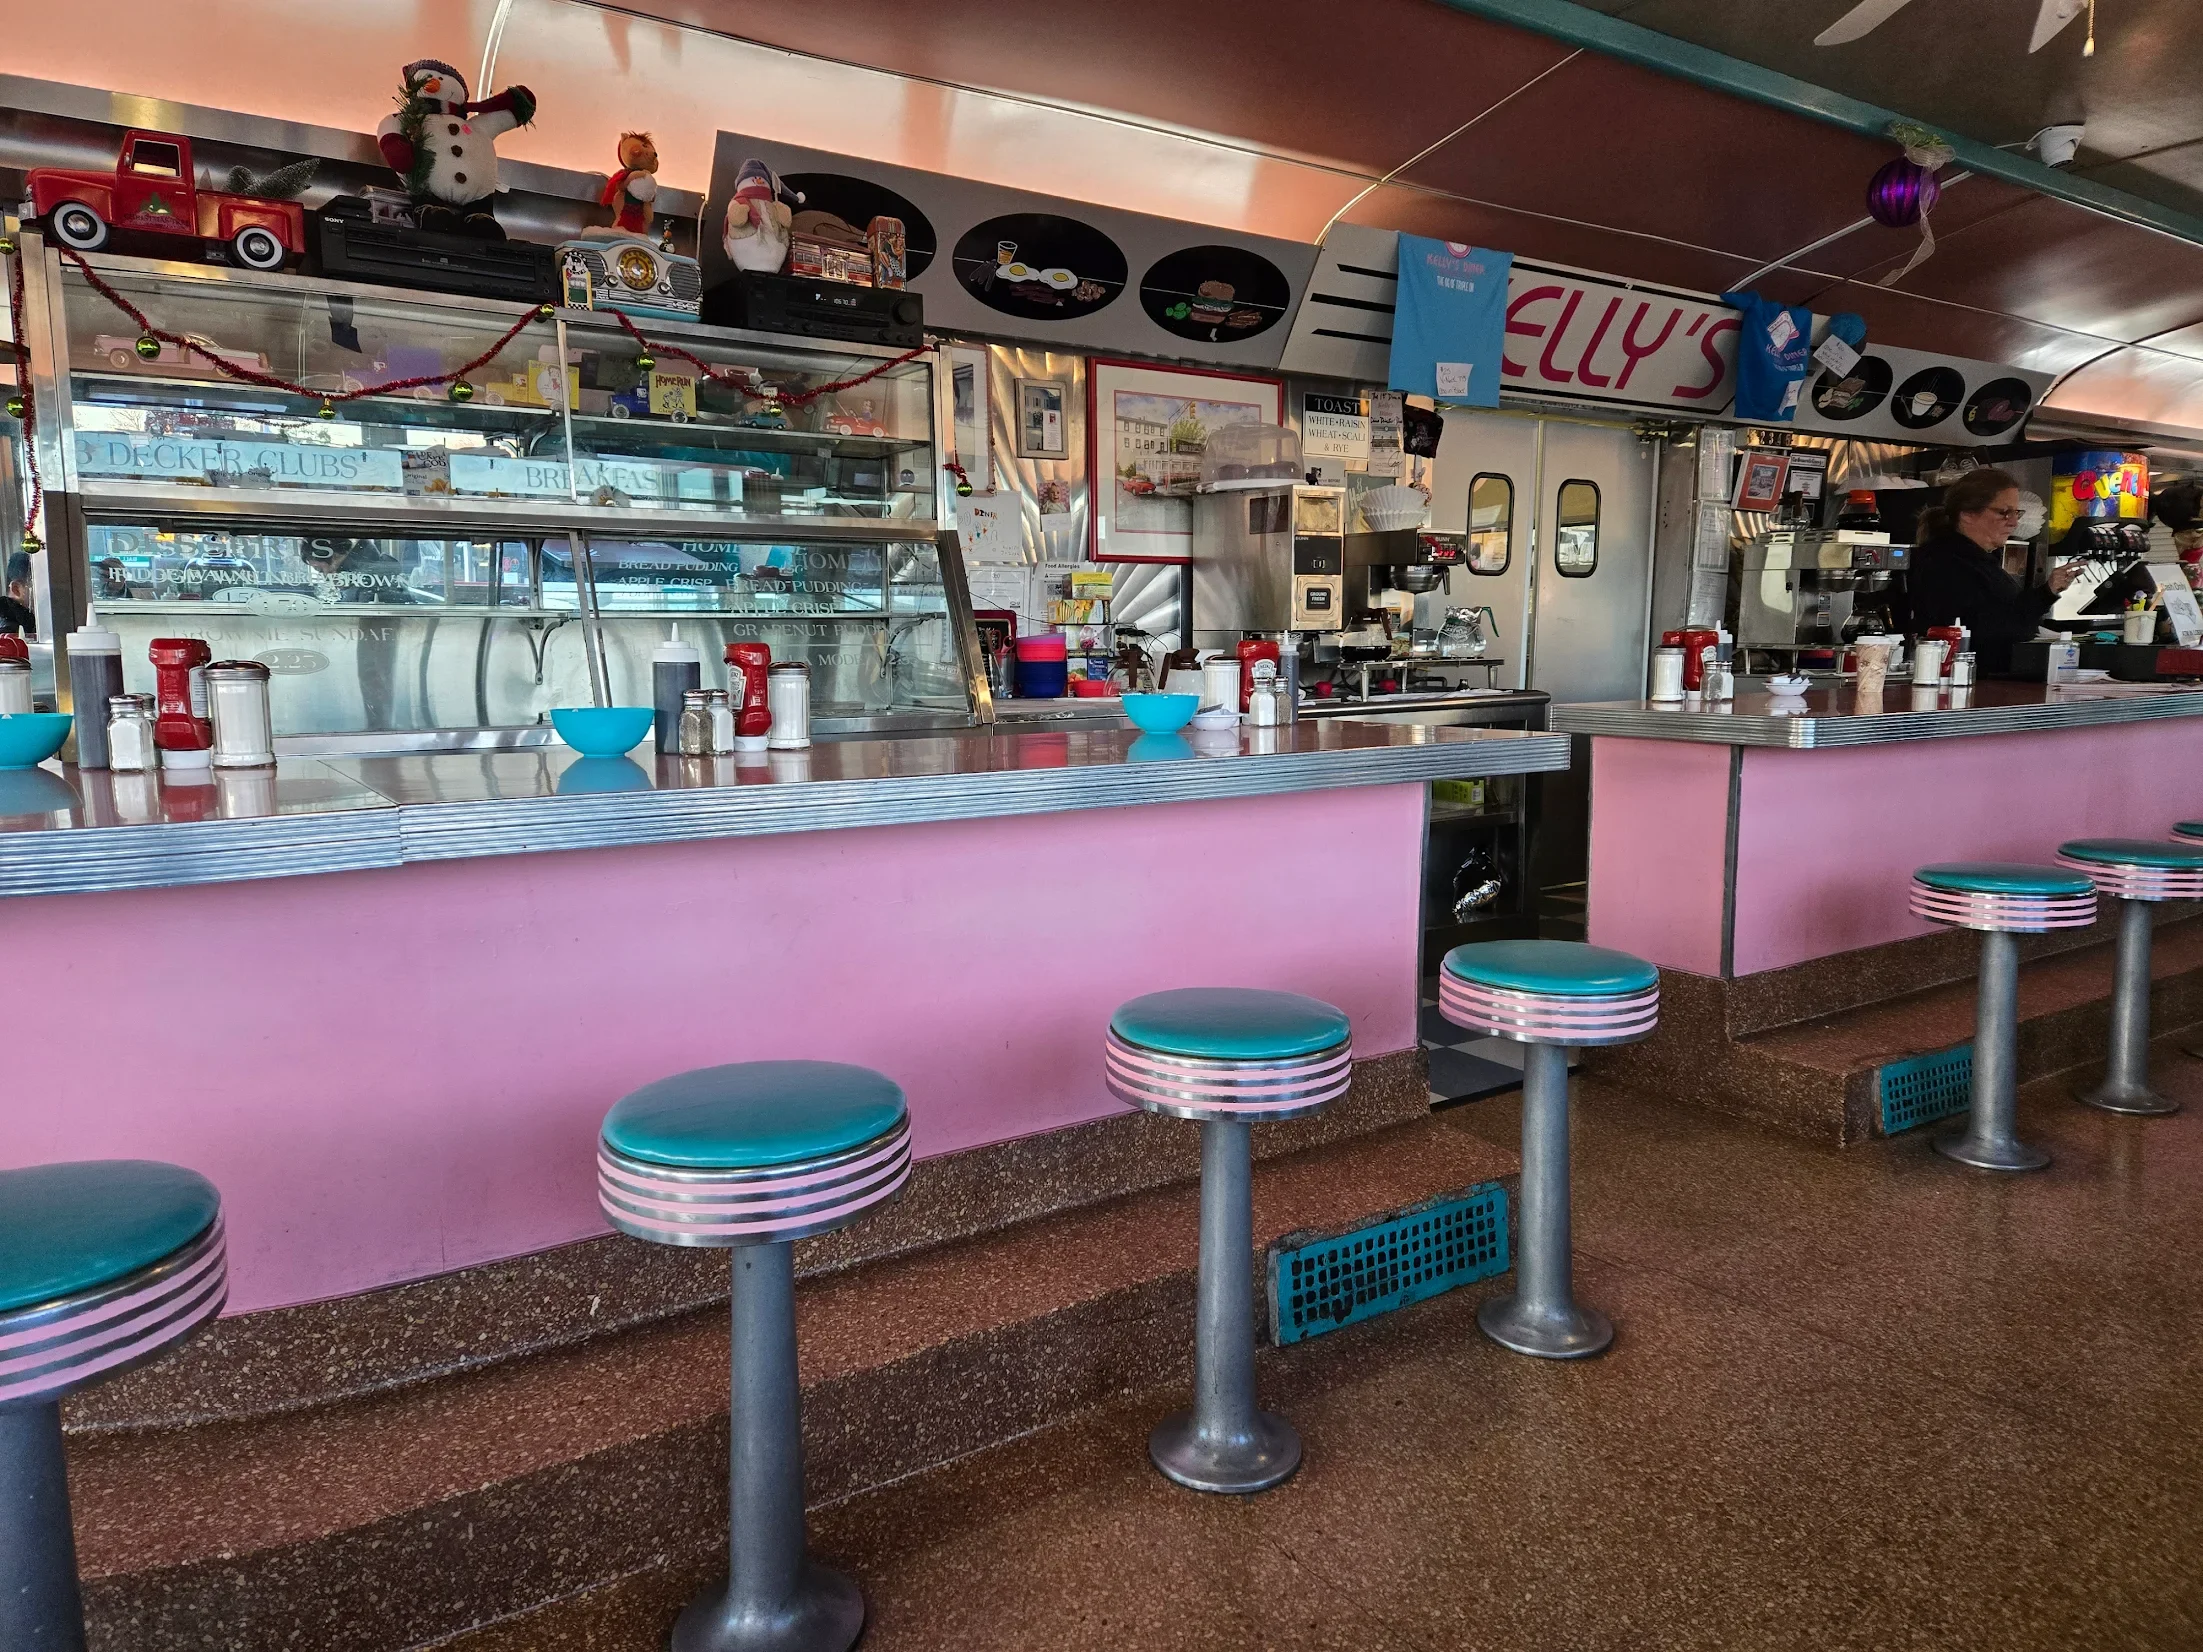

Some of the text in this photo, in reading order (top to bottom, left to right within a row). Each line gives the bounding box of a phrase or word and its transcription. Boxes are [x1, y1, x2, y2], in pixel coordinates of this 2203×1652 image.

[324, 216, 345, 224] SONY
[1426, 253, 1486, 275] KELLY'S DINER
[1502, 278, 1743, 399] ELLY'S
[1314, 397, 1361, 414] TOAST
[1308, 415, 1335, 426] WHITE
[1339, 416, 1366, 429] RAISIN
[1308, 428, 1337, 438] WHEAT
[1760, 430, 1766, 445] 2
[1768, 431, 1774, 446] 3
[1324, 443, 1349, 453] & RYE
[108, 441, 243, 473] DECKER
[255, 449, 358, 479] CLUBS
[526, 465, 664, 491] BREAKFAS
[618, 560, 739, 572] BREAD PUDDING
[616, 577, 713, 587] APPLE CRISP
[725, 578, 864, 595] BREAD PUDDING
[729, 601, 839, 614] APPLE CRISP
[733, 623, 900, 638] GRAPENUT PUDDIN
[265, 654, 317, 669] 2.25
[818, 654, 865, 666] MODE
